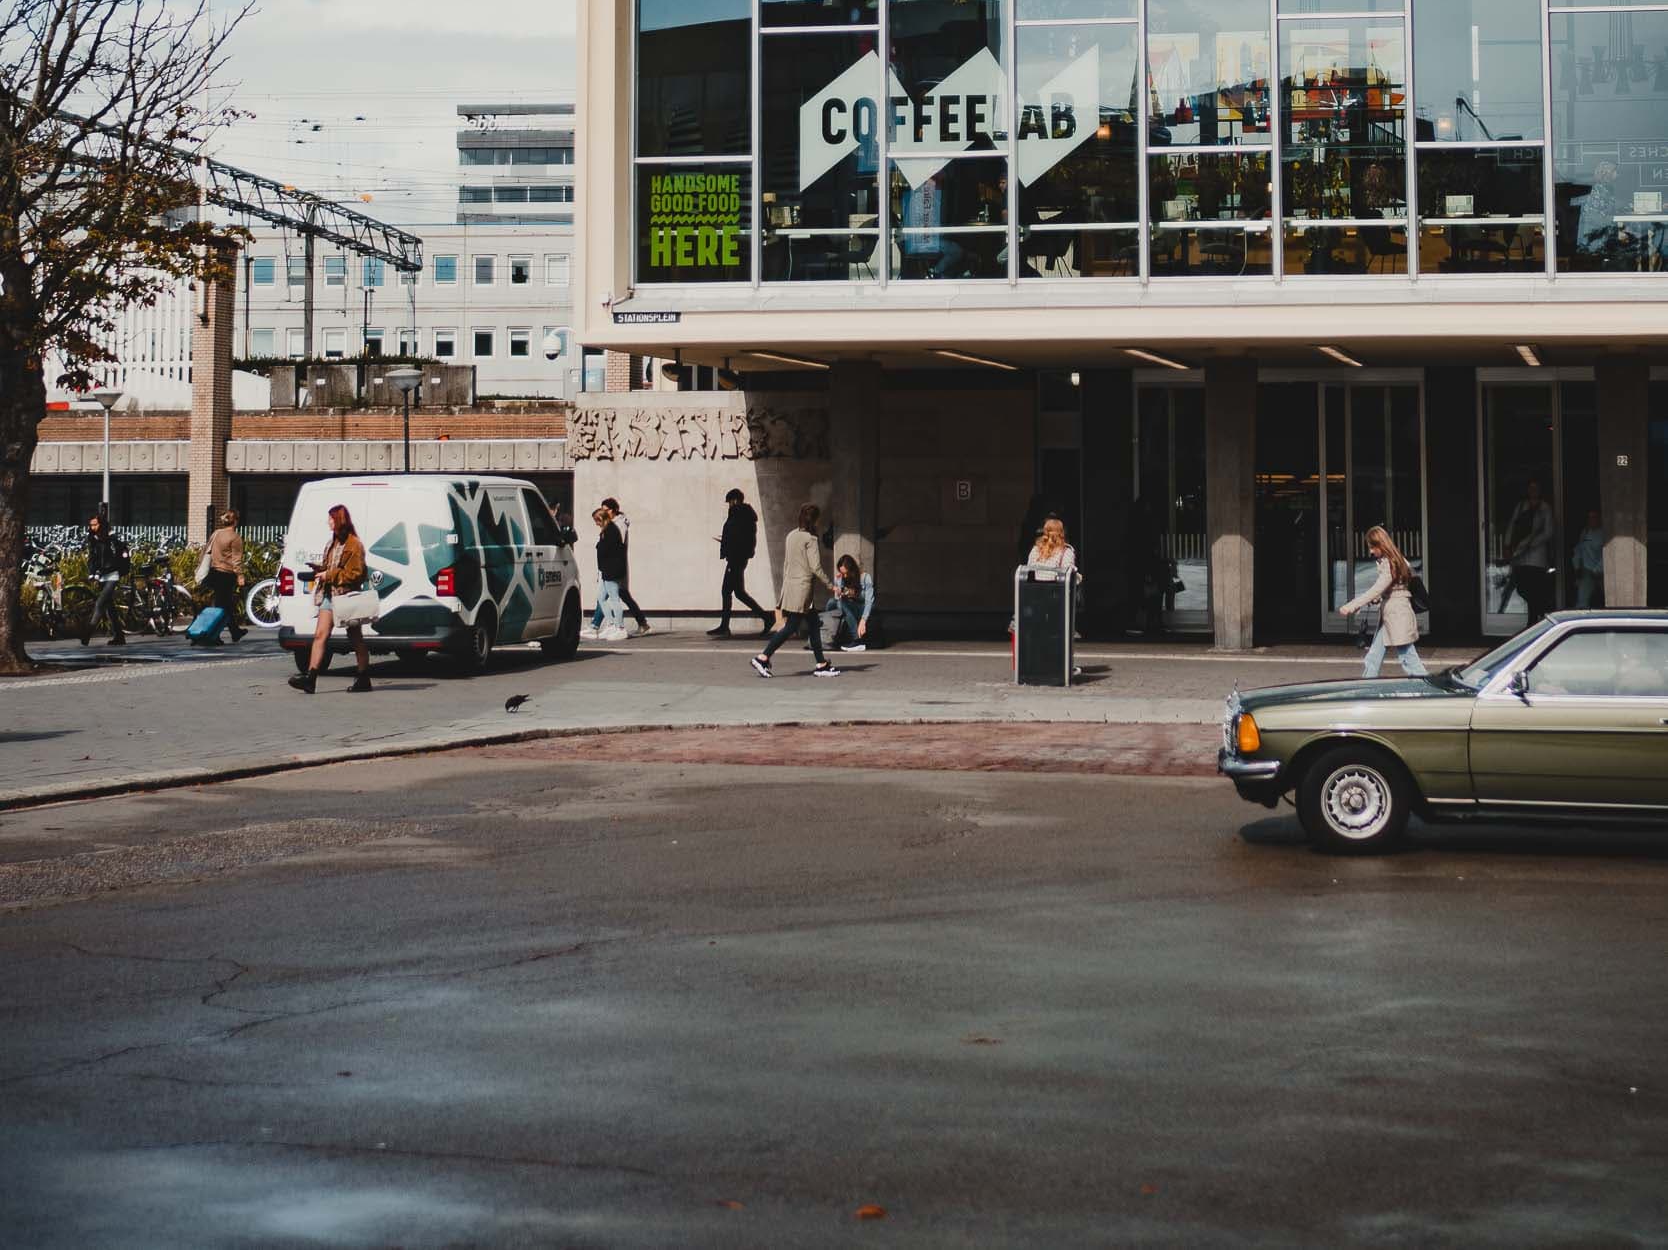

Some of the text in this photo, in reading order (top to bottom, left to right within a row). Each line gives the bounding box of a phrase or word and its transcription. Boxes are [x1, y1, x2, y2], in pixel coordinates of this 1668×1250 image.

[651, 174, 741, 194] HANDSOME
[651, 193, 741, 213] GOOD FOOD
[650, 225, 741, 267] HERE
[618, 313, 676, 323] STATIONSPLEIN
